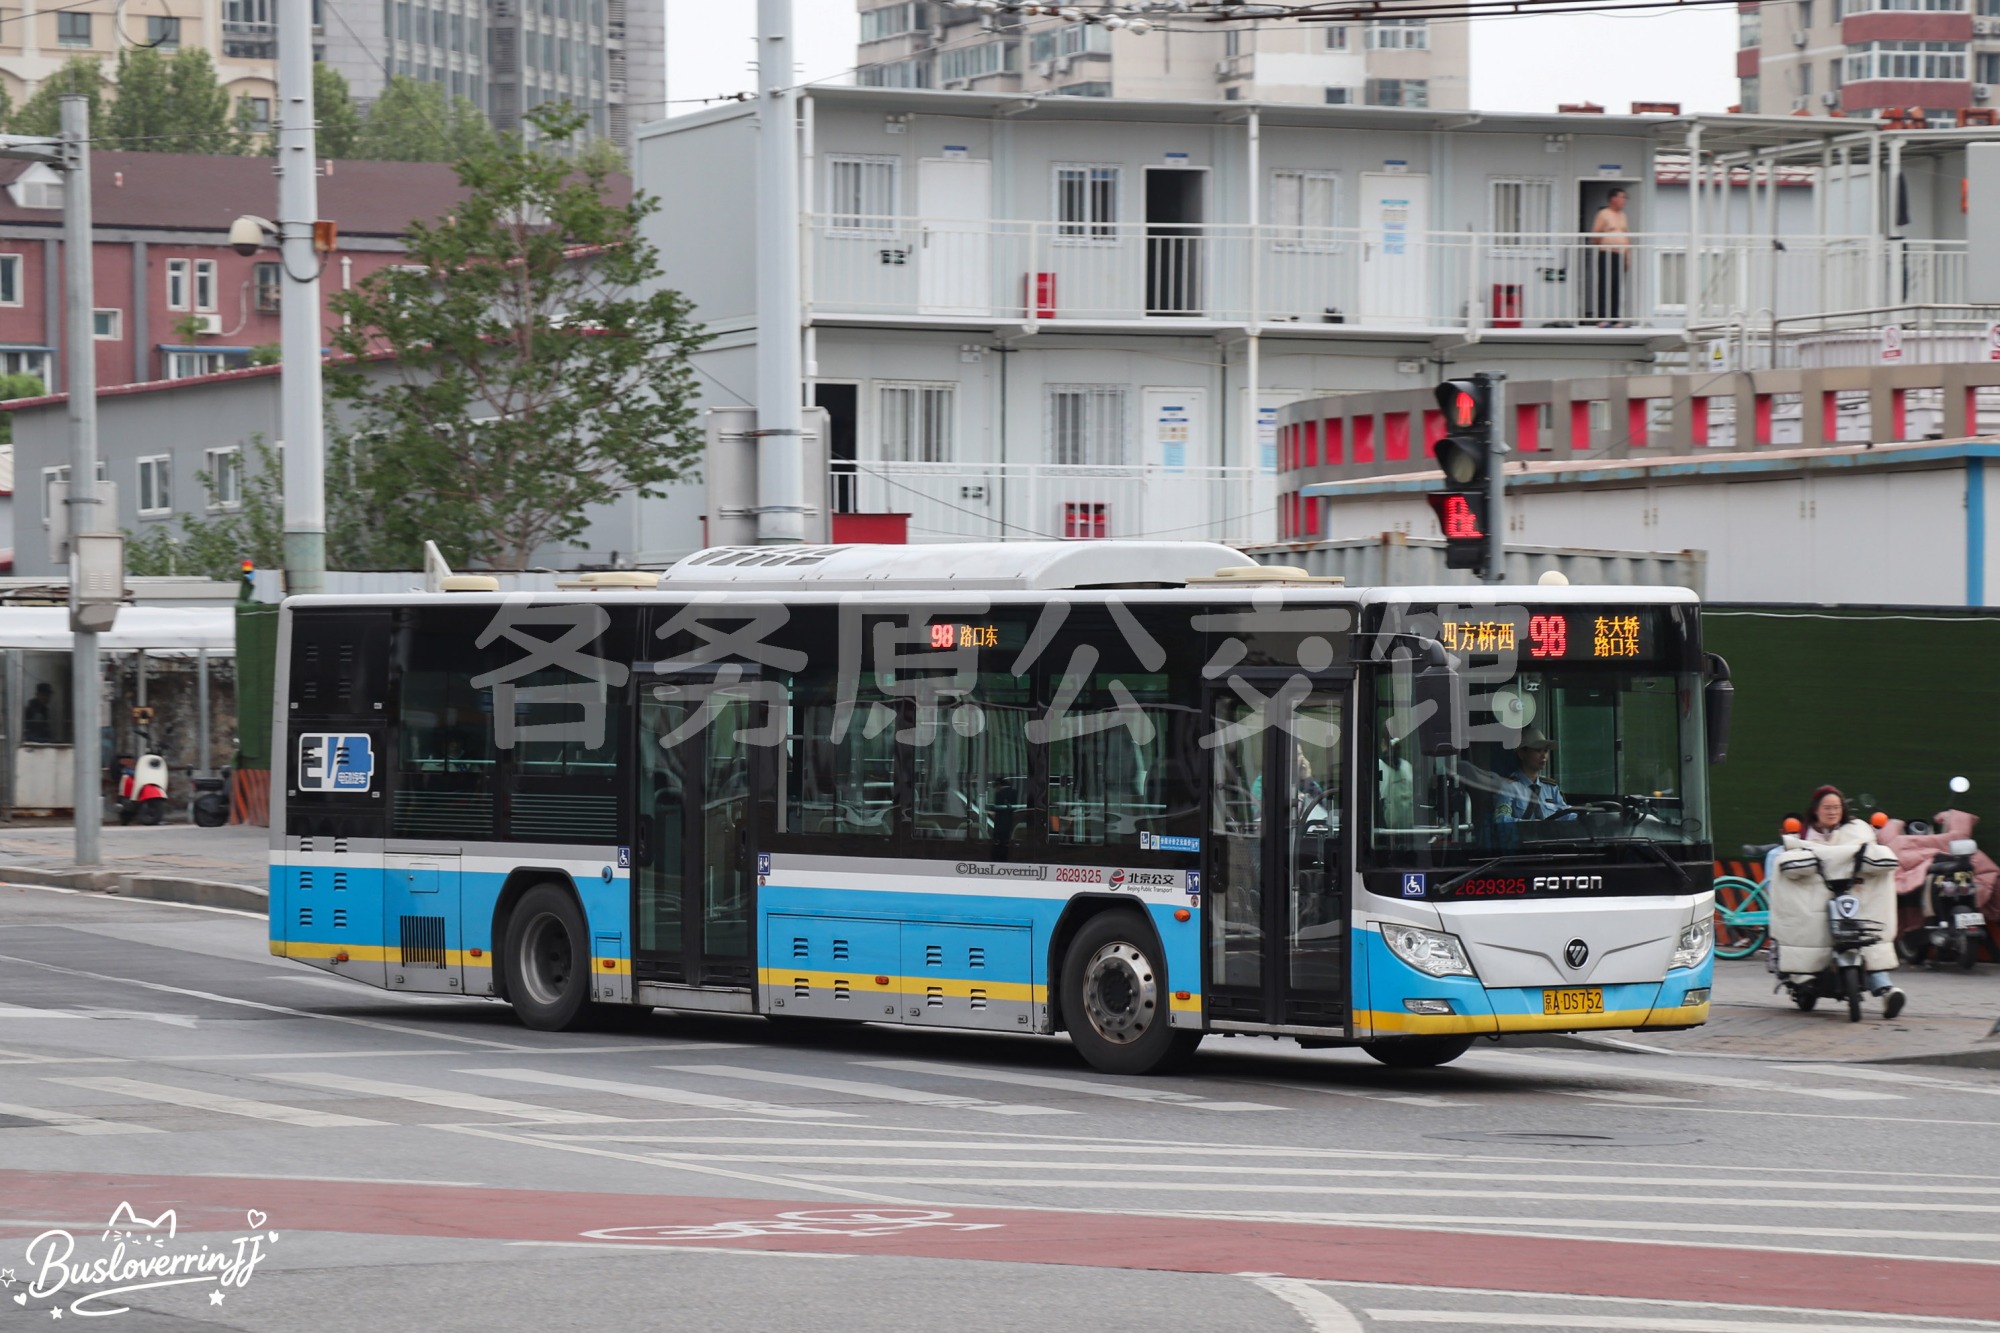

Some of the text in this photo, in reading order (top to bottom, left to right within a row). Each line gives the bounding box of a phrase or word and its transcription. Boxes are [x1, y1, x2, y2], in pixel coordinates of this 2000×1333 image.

[931, 624, 954, 648] 98
[960, 624, 999, 648] 路口东
[1442, 621, 1515, 652] 四方桥西
[1530, 615, 1566, 657] 98
[1594, 615, 1640, 637] 东大桥
[1593, 637, 1640, 657] 路口东
[1056, 867, 1102, 883] 2629325
[1128, 872, 1175, 885] 北京公交
[1455, 878, 1526, 896] 2629325
